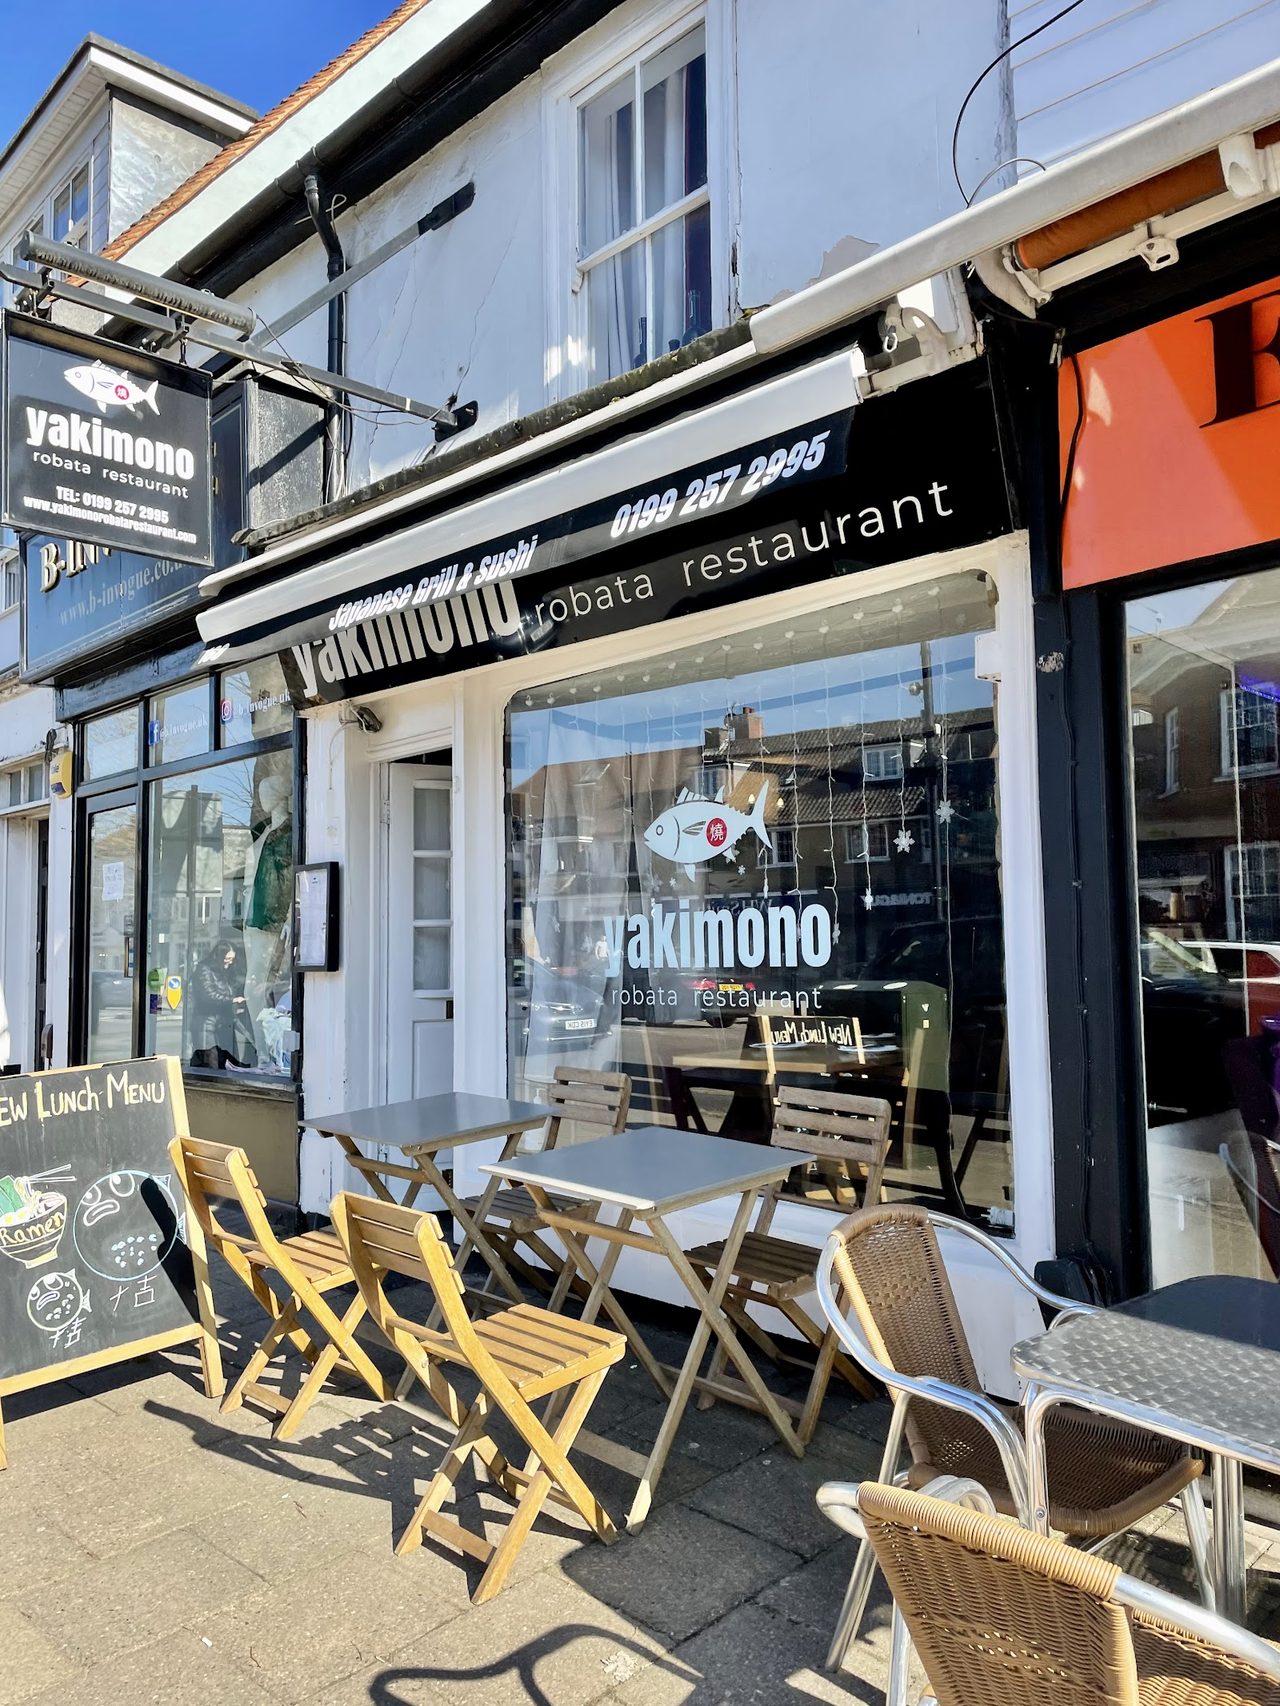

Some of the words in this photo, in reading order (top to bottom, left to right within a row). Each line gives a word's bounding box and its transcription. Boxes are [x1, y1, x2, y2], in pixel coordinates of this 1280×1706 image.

[25, 406, 195, 480] yakimono
[33, 450, 92, 475] robata
[102, 468, 189, 499] restaurant
[56, 485, 81, 502] TEL:
[82, 491, 113, 511] 0199
[114, 499, 138, 517] 257
[138, 504, 169, 524] 2995
[610, 486, 679, 538] 0199
[679, 464, 743, 516] 257
[740, 429, 832, 496] 2995
[23, 495, 197, 545] www.yakimonorobatarestaurant.com
[534, 573, 655, 627] robata
[682, 481, 953, 587] restaurant
[328, 583, 414, 630] Japanese
[411, 563, 459, 605] Grill
[456, 562, 474, 591] &
[290, 579, 522, 698] yakimono
[603, 898, 832, 978] yakimono
[612, 984, 678, 1006] robata
[694, 986, 823, 1009] restaurant
[0, 1212, 65, 1247] Ramen
